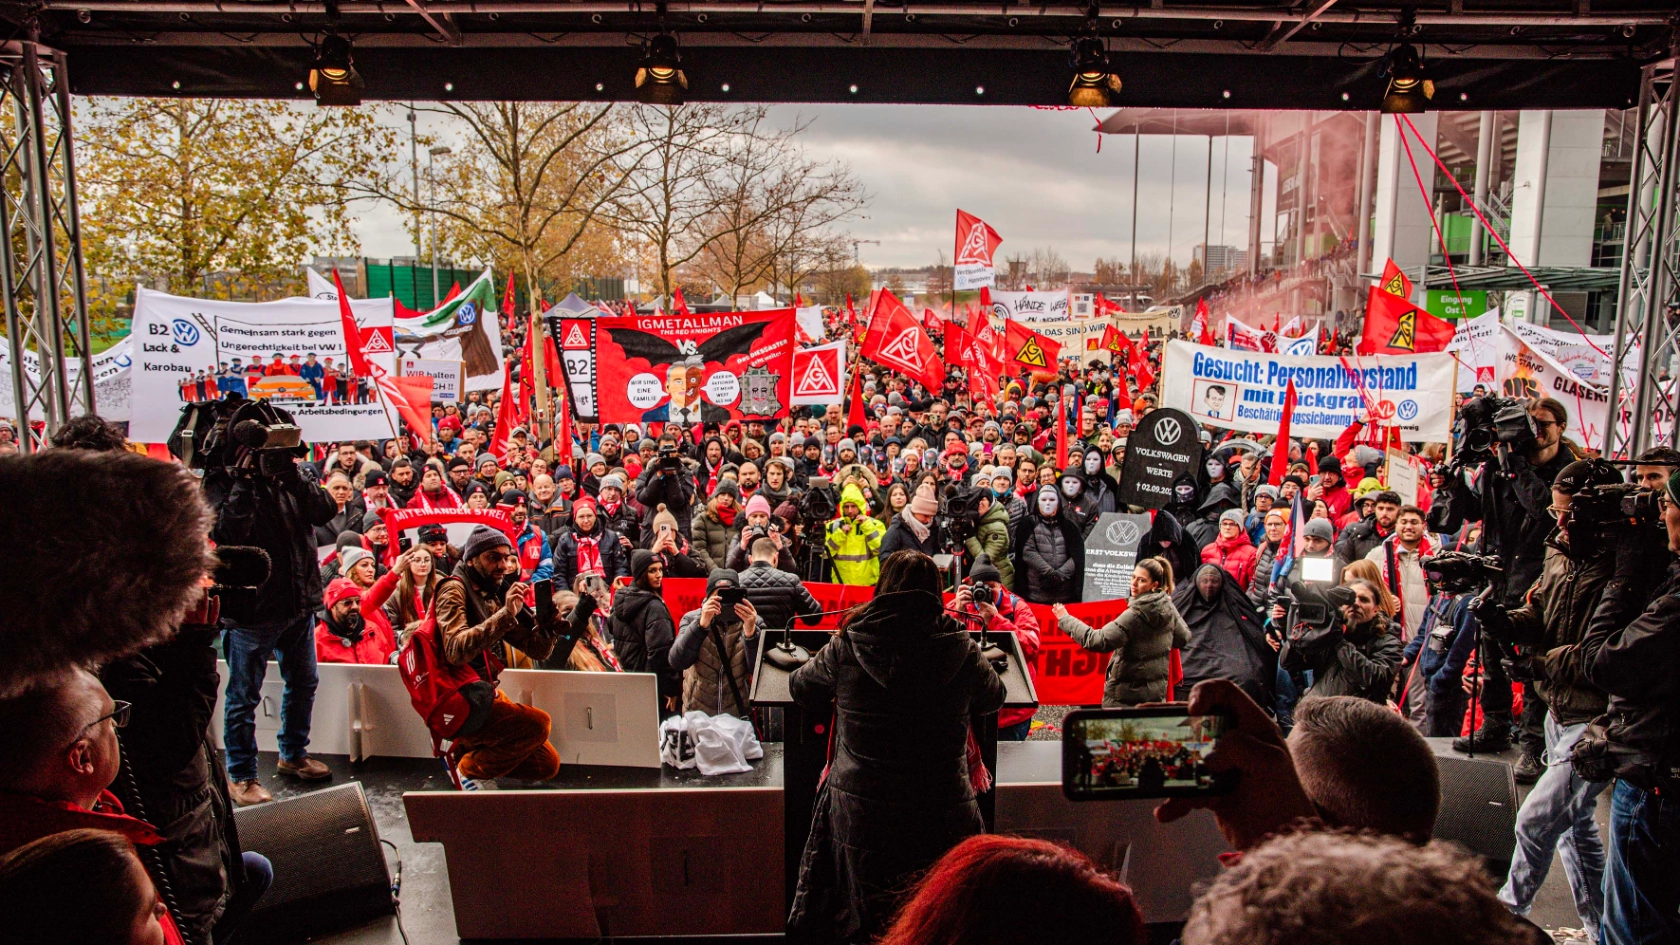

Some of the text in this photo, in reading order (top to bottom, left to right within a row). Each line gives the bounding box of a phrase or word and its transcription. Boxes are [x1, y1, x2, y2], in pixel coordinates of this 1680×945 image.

[1444, 305, 1460, 315] Ost
[637, 315, 744, 330] IGMETALLMAN
[149, 323, 170, 336] B2
[220, 325, 337, 338] Gemeinsam stark gegen
[691, 327, 721, 335] KNIGHTS
[1044, 328, 1063, 336] DAS
[1089, 323, 1106, 332] WIR
[143, 342, 181, 354] Lack &
[221, 341, 300, 352] Ungerechtigkeit
[318, 343, 336, 351] VW
[1505, 352, 1517, 363] WE
[143, 362, 192, 373] Karobau
[566, 359, 588, 375] B2
[1192, 351, 1417, 391] Gesucht: Personalvorstand
[1519, 358, 1544, 373] STAND
[1243, 387, 1275, 403] mit
[298, 408, 383, 416] Arbeitsbedingungen
[1135, 446, 1191, 463] VOLKSWAGEN
[1146, 466, 1173, 479] WERTE
[394, 507, 506, 522] MITEINANDER STREI
